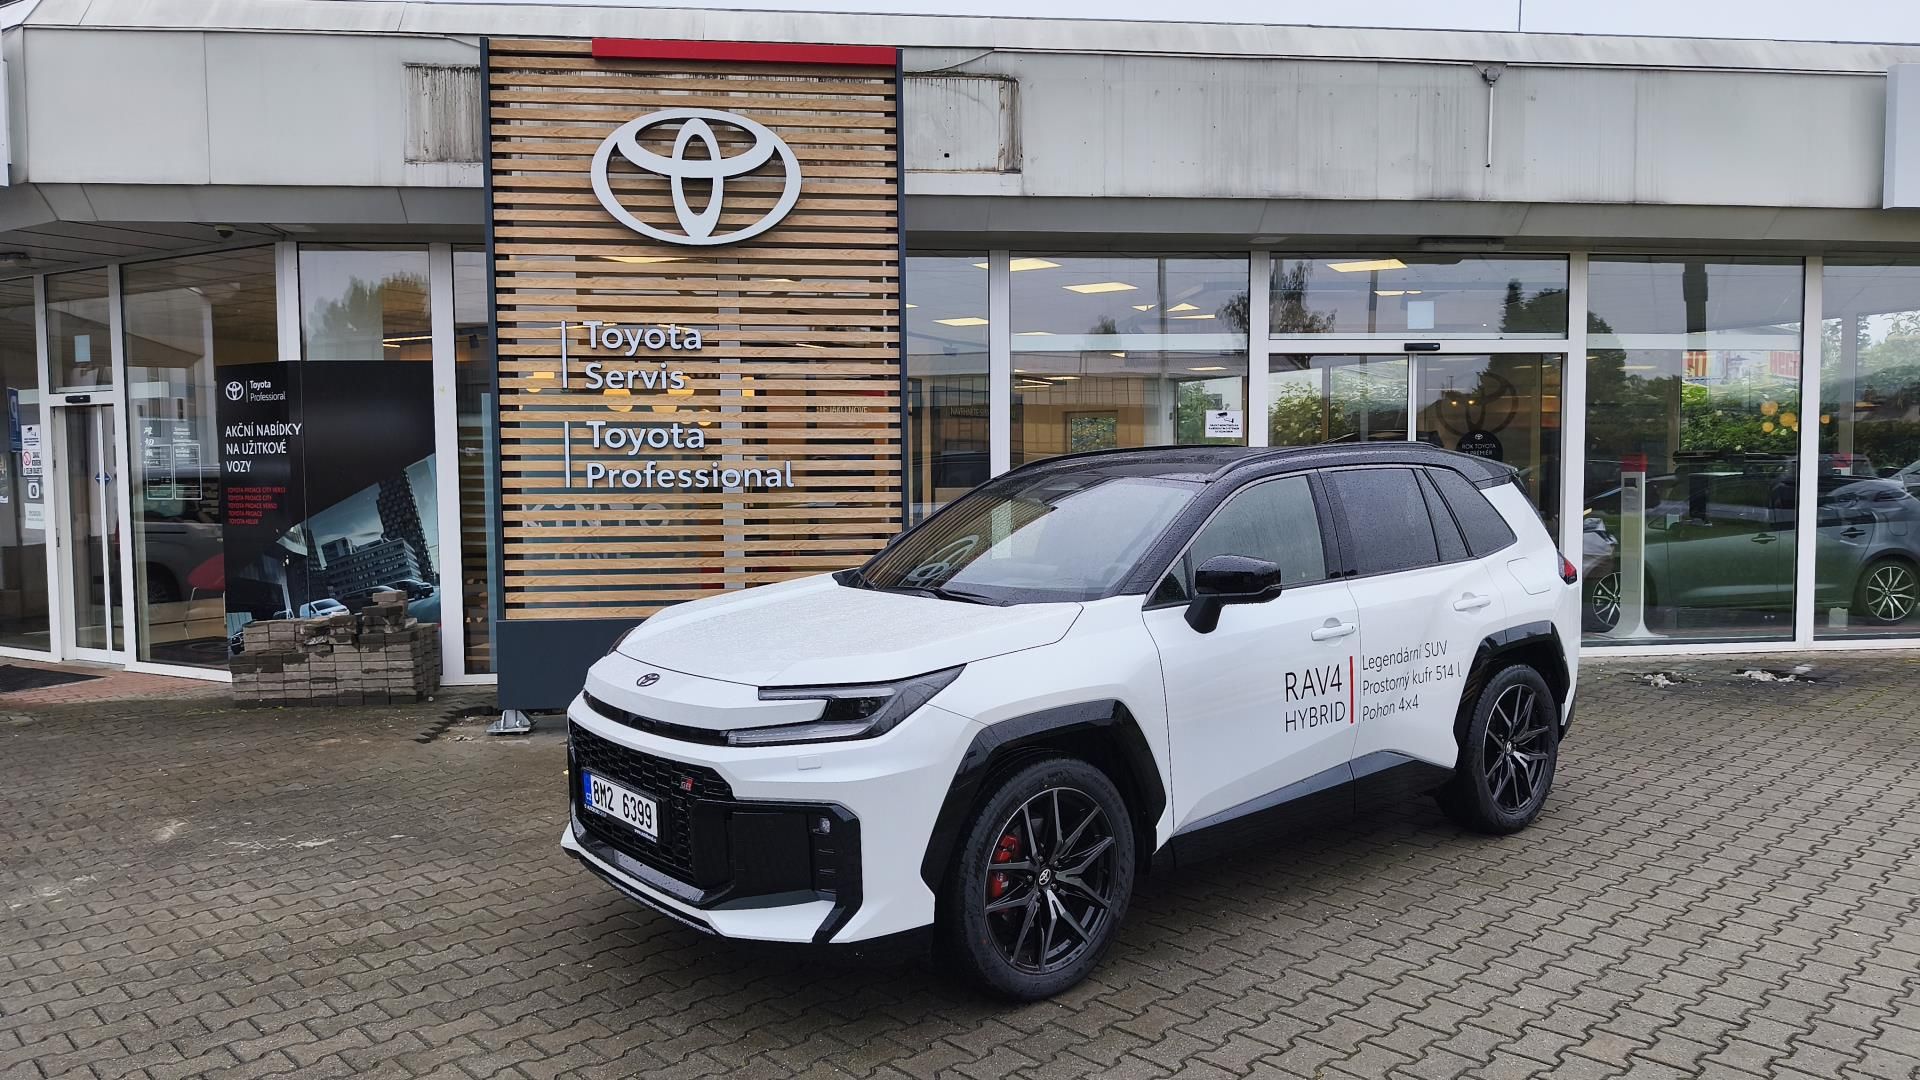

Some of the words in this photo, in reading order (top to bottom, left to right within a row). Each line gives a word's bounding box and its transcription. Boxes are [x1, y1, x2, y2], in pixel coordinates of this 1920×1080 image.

[582, 320, 703, 356] Toyota
[250, 380, 271, 391] Toyota
[584, 363, 686, 390] Servis
[250, 391, 286, 401] Professional
[225, 421, 254, 437] AKČNÍ
[256, 420, 302, 436] NABÍDKY
[585, 420, 706, 455] Toyota
[226, 443, 240, 455] NA
[242, 438, 287, 455] UŽITKOVÉ
[226, 460, 252, 473] VOZY
[585, 459, 795, 489] Professional
[1362, 646, 1422, 673] Legendární
[1424, 640, 1448, 658] SUV
[1285, 663, 1343, 702] RAV4
[1362, 674, 1410, 696] Prostorný
[1412, 669, 1433, 686] kufr
[1436, 663, 1454, 681] 514
[1285, 701, 1346, 733] HYBRID
[1362, 701, 1396, 722] Pohon
[1398, 694, 1419, 711] 4x4
[593, 780, 615, 812] 8M2
[622, 793, 652, 829] 6399
